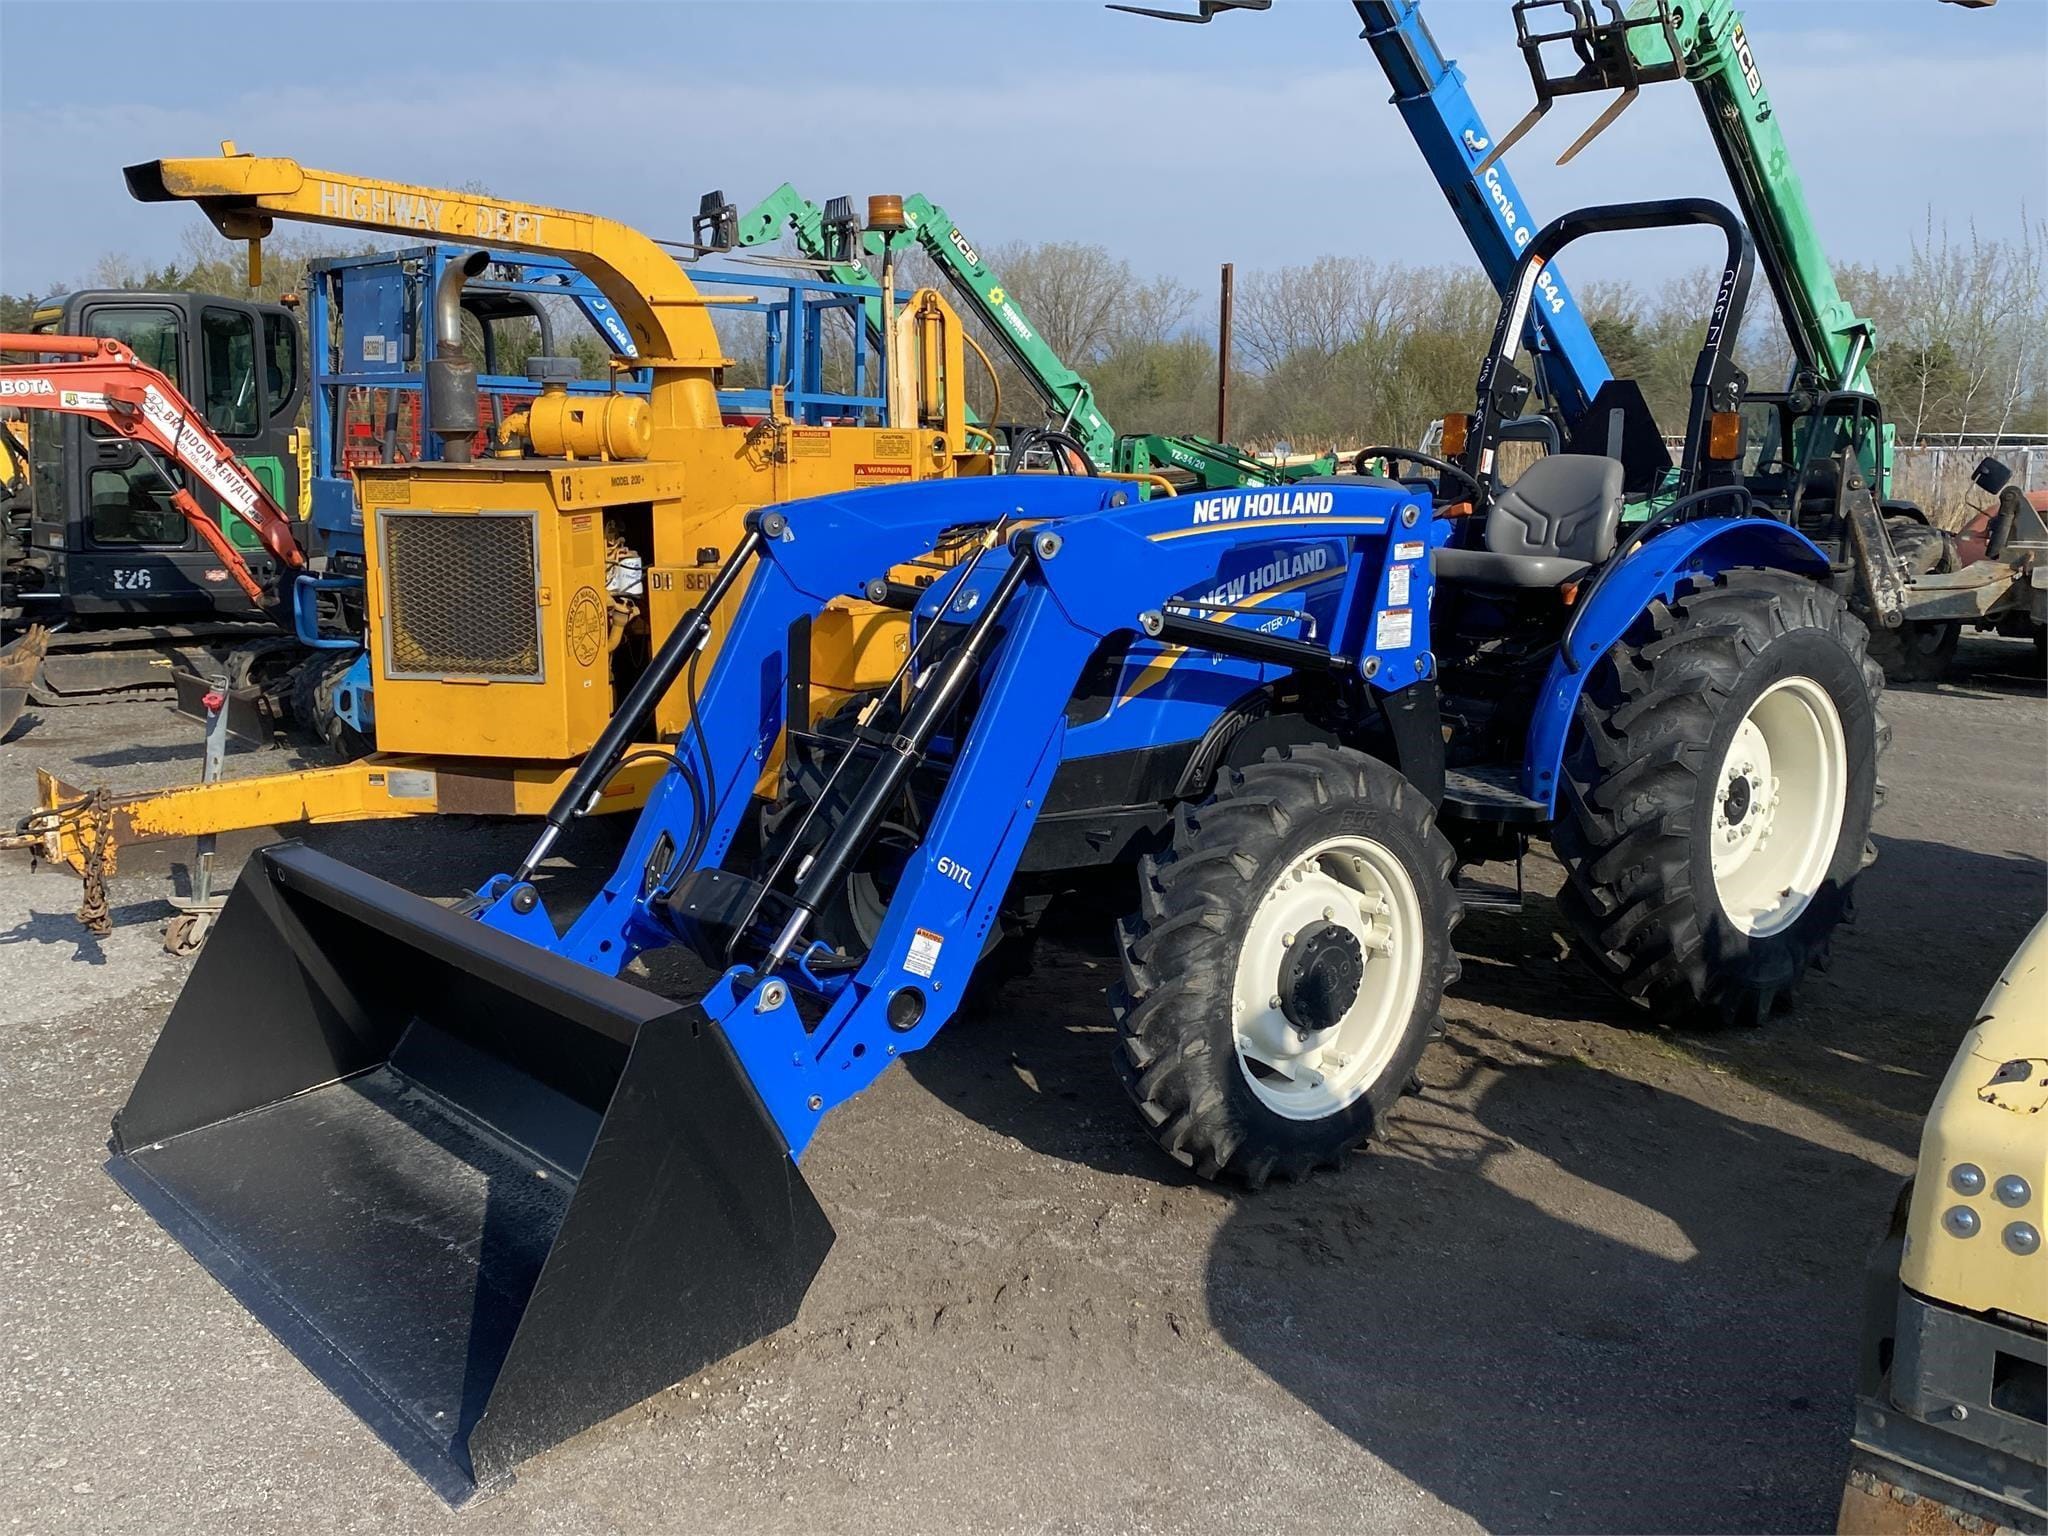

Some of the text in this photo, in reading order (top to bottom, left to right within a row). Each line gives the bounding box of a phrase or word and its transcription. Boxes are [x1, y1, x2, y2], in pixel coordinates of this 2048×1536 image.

[1732, 24, 1761, 97] JCB
[320, 181, 545, 246] HIGHWAY DEPT
[1485, 167, 1516, 230] Genie
[949, 229, 979, 267] JCB
[606, 317, 627, 346] Genie
[163, 410, 254, 505] BRANDON RENTALL
[1171, 449, 1205, 470] TZ-34/20
[561, 476, 572, 501] 13
[611, 476, 629, 487] MODEL
[1193, 492, 1333, 524] NEW HOLLAND
[1200, 574, 1246, 618] NEW
[1249, 549, 1327, 593] HOLLAND
[938, 857, 972, 890] 611TL
